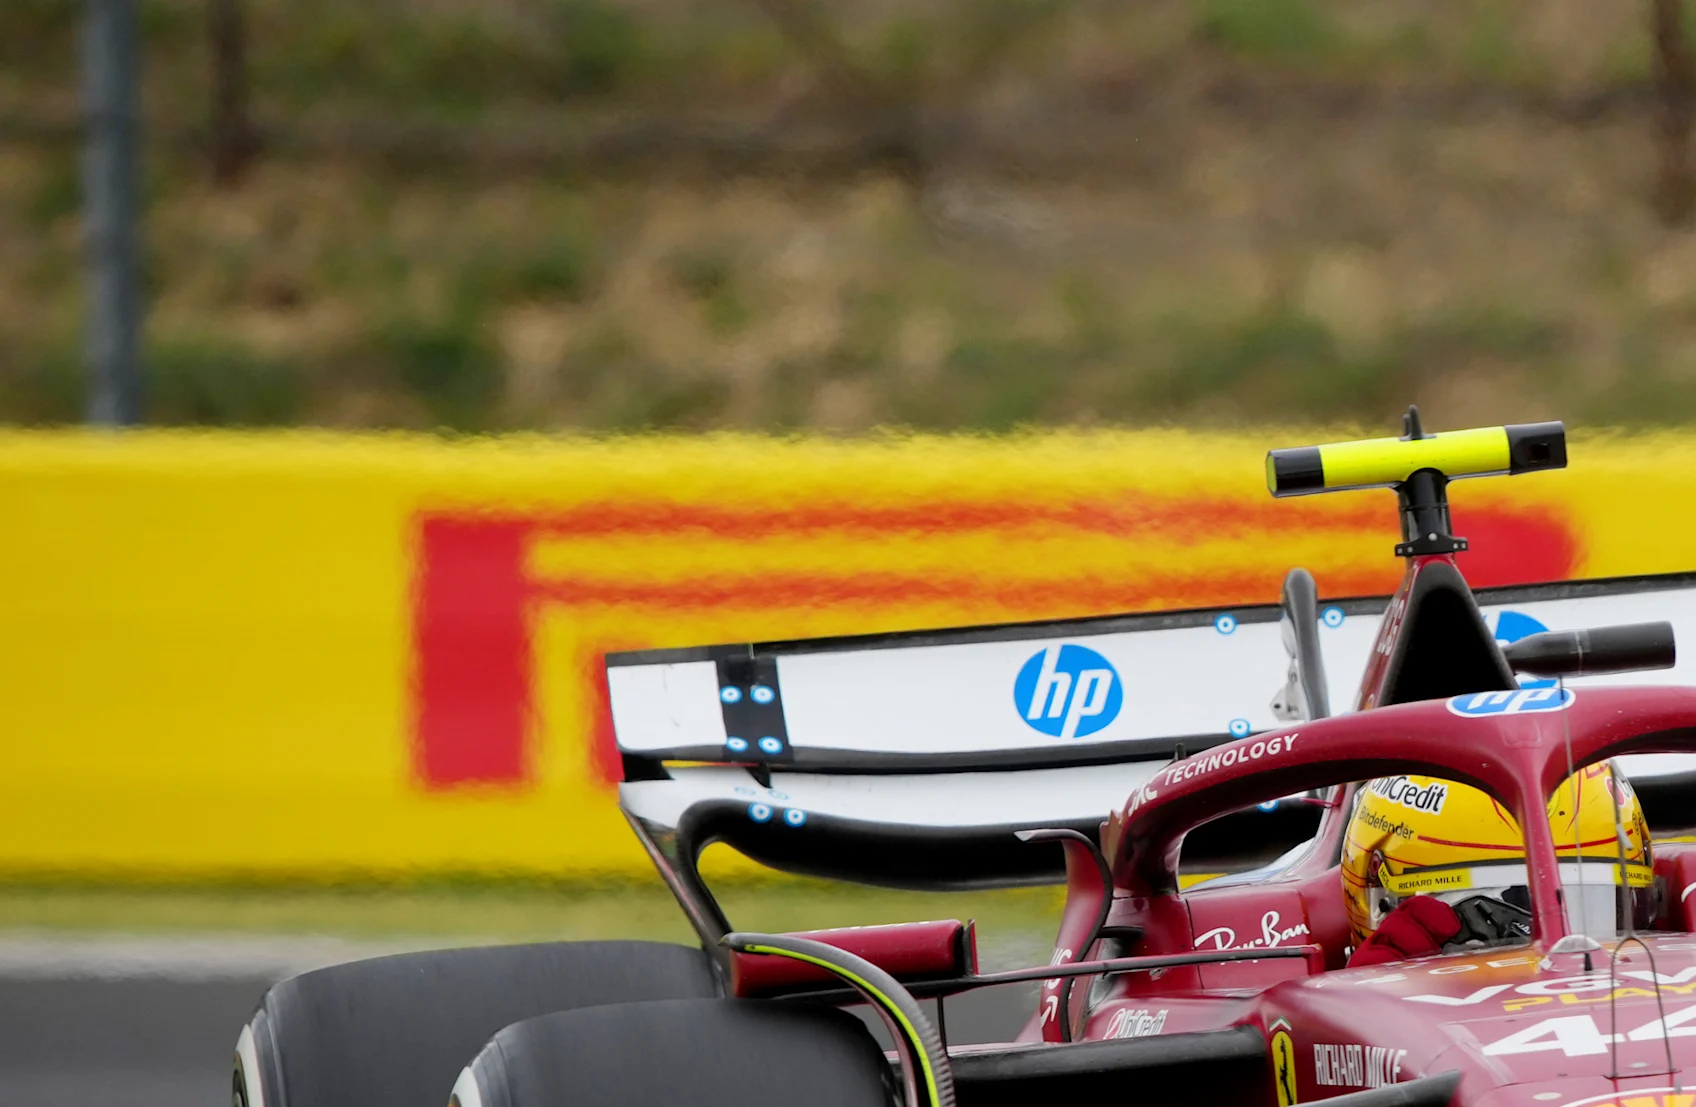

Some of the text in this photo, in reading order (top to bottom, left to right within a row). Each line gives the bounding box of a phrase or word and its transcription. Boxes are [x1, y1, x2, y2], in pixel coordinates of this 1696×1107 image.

[1027, 645, 1113, 738] hp
[1164, 733, 1299, 786] TECHNOLOGY
[1358, 806, 1415, 840] Bitdefender
[1398, 874, 1463, 890] RICHARD MILLE
[1193, 910, 1310, 966] R-Ban
[1313, 1043, 1363, 1086] RICHARD
